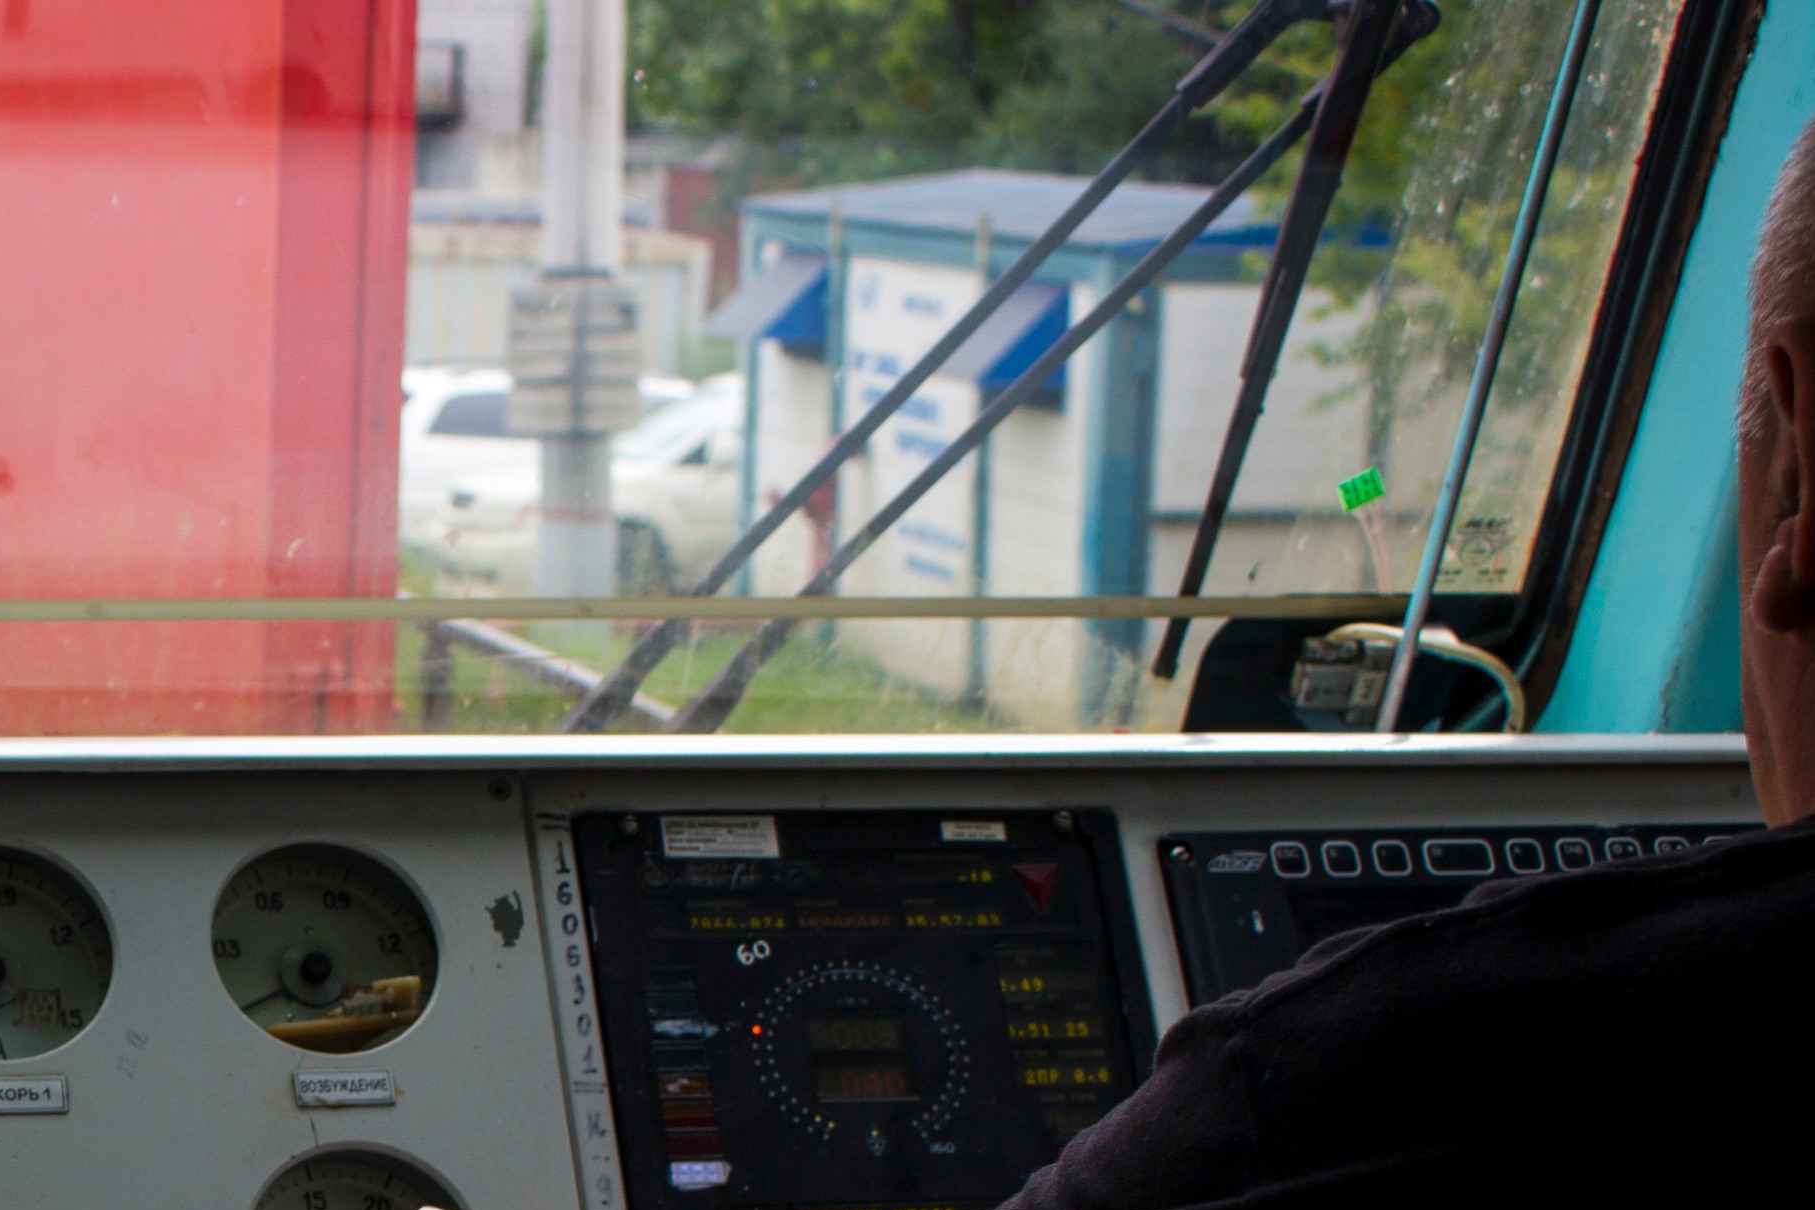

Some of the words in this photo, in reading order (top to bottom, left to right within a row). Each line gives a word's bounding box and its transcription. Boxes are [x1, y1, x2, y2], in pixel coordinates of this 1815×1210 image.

[735, 939, 772, 968] 60
[299, 1078, 390, 1093] ВОЗБУЖДЕНИЕ
[44, 1088, 51, 1100] 1
